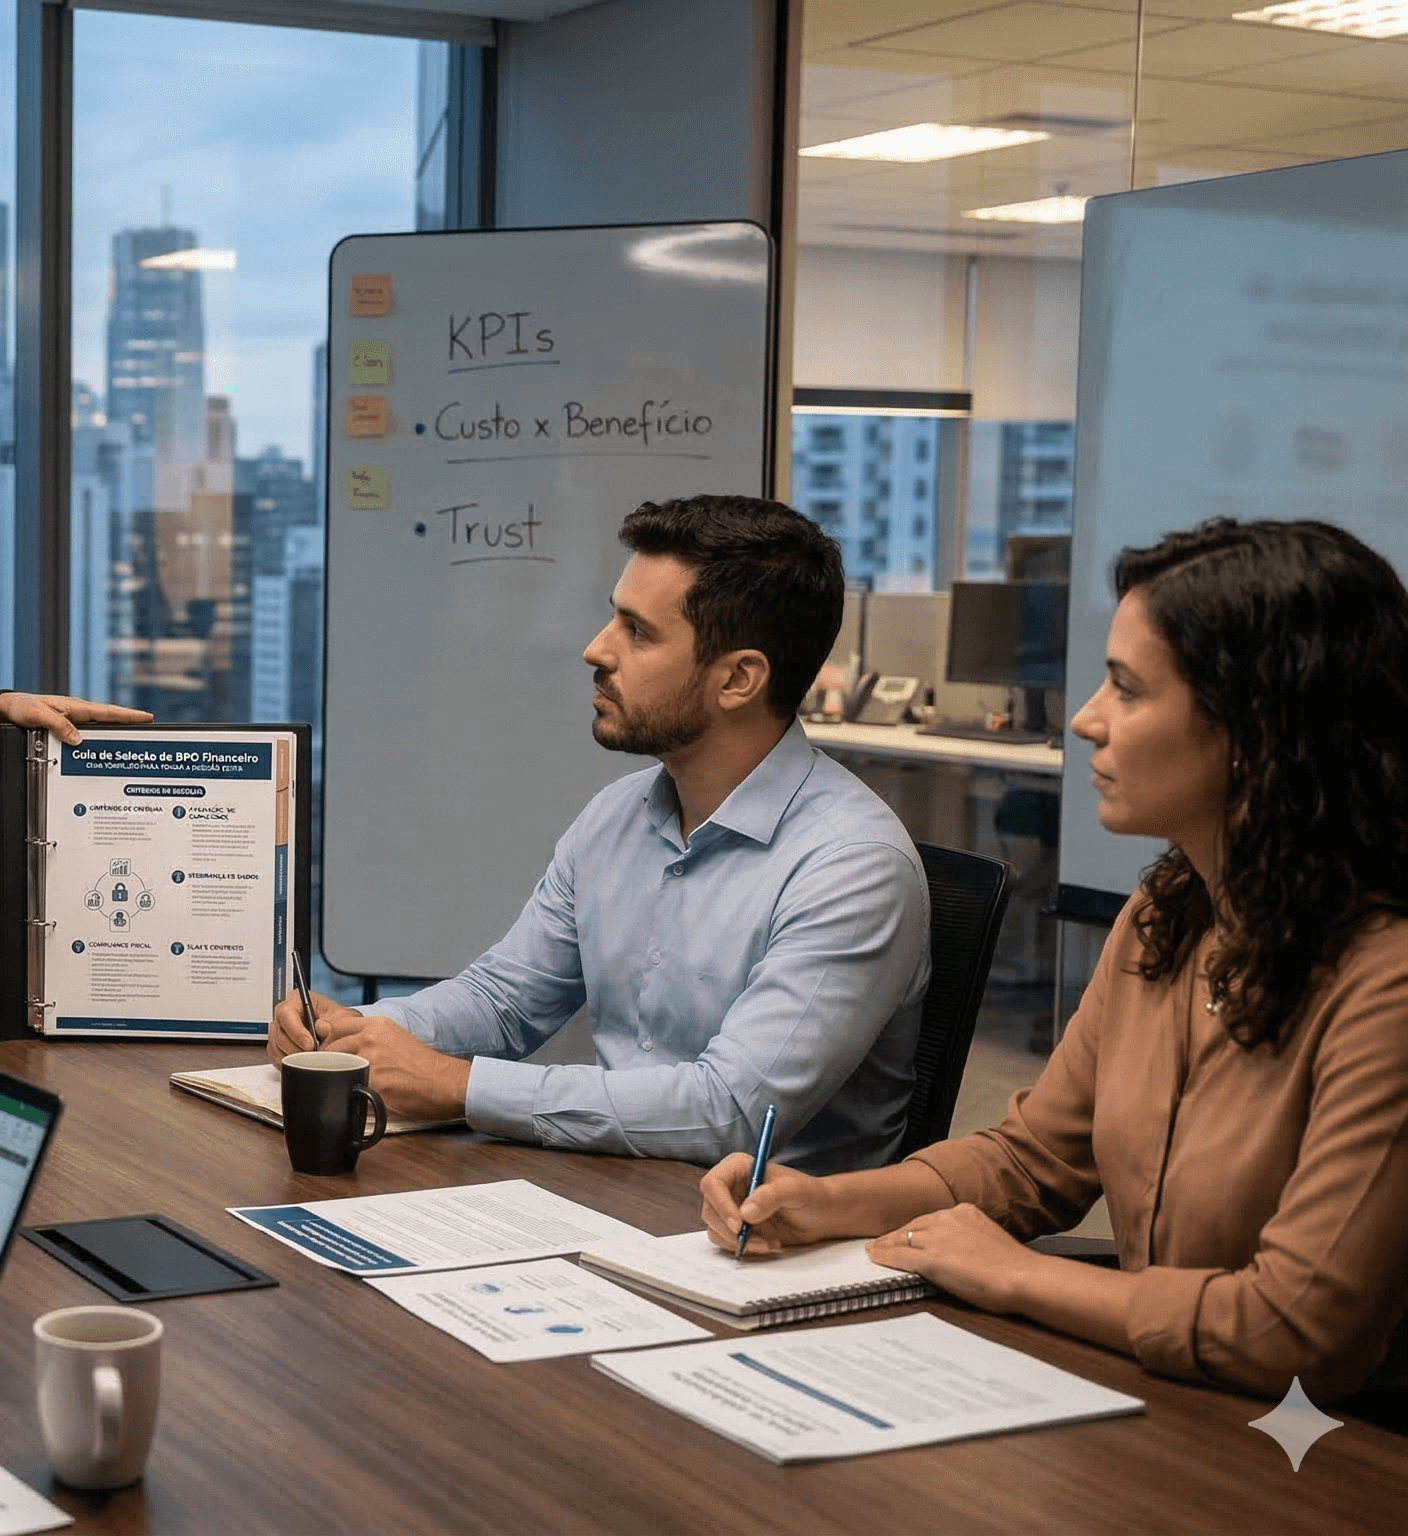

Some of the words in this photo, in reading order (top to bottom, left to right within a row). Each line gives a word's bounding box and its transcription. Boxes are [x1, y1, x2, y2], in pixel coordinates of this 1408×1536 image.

[449, 312, 554, 360] KPIs
[435, 402, 520, 440] Custo
[563, 400, 712, 446] Benefício
[435, 503, 543, 549] Trust
[99, 750, 113, 760] de
[159, 752, 173, 762] de
[175, 752, 200, 762] BPO
